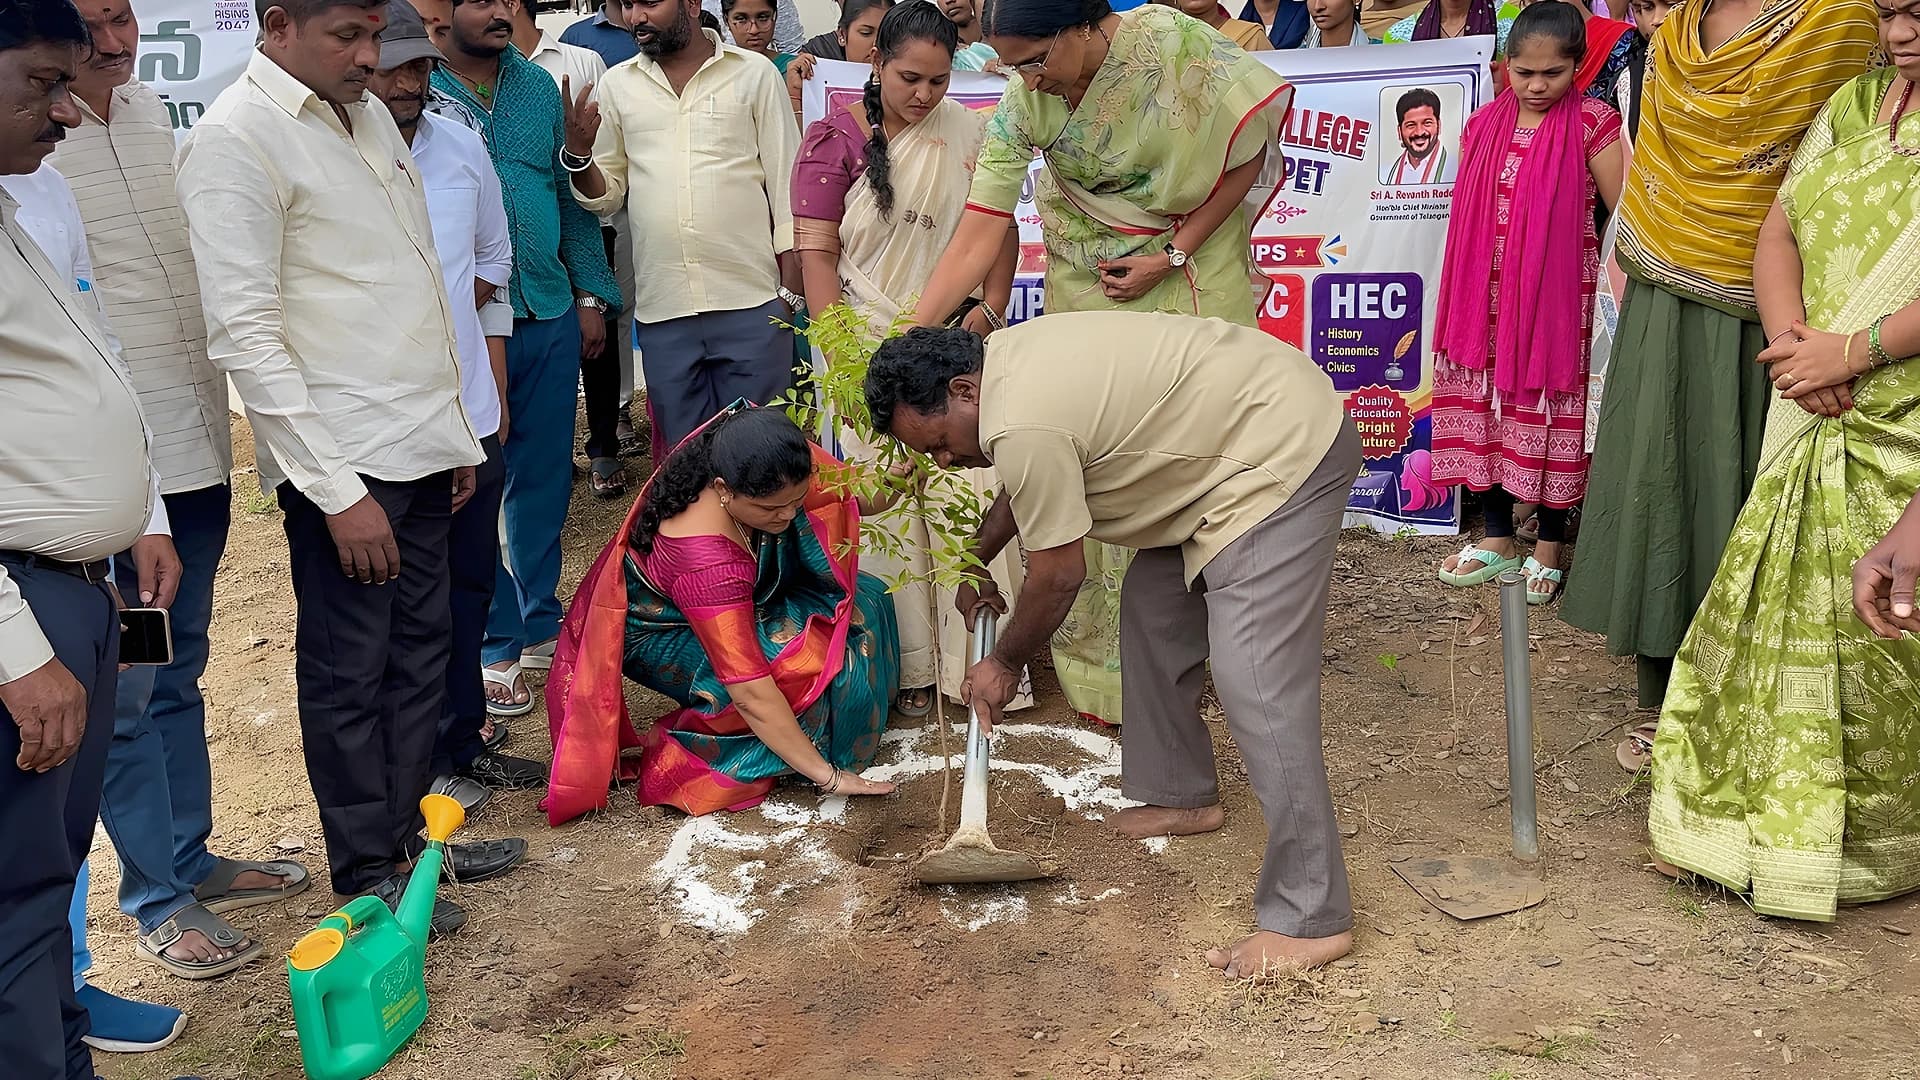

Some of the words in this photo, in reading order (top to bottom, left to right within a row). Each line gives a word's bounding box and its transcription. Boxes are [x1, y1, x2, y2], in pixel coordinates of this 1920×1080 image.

[214, 9, 250, 19] RISING
[215, 20, 250, 31] 2047
[1281, 107, 1370, 160] LLEGE
[1370, 190, 1382, 200] Sri
[1384, 190, 1393, 199] A.
[1396, 189, 1430, 199] Revanth
[1250, 244, 1287, 262] PS
[1258, 282, 1289, 319] C
[1330, 282, 1407, 319] HEC
[1327, 328, 1362, 341] History
[1327, 344, 1379, 356] Economics
[1327, 361, 1356, 373] Civics
[1357, 396, 1393, 408] Quality
[1350, 408, 1401, 418] Education
[1357, 421, 1395, 435] Bright
[1361, 436, 1396, 447] uture
